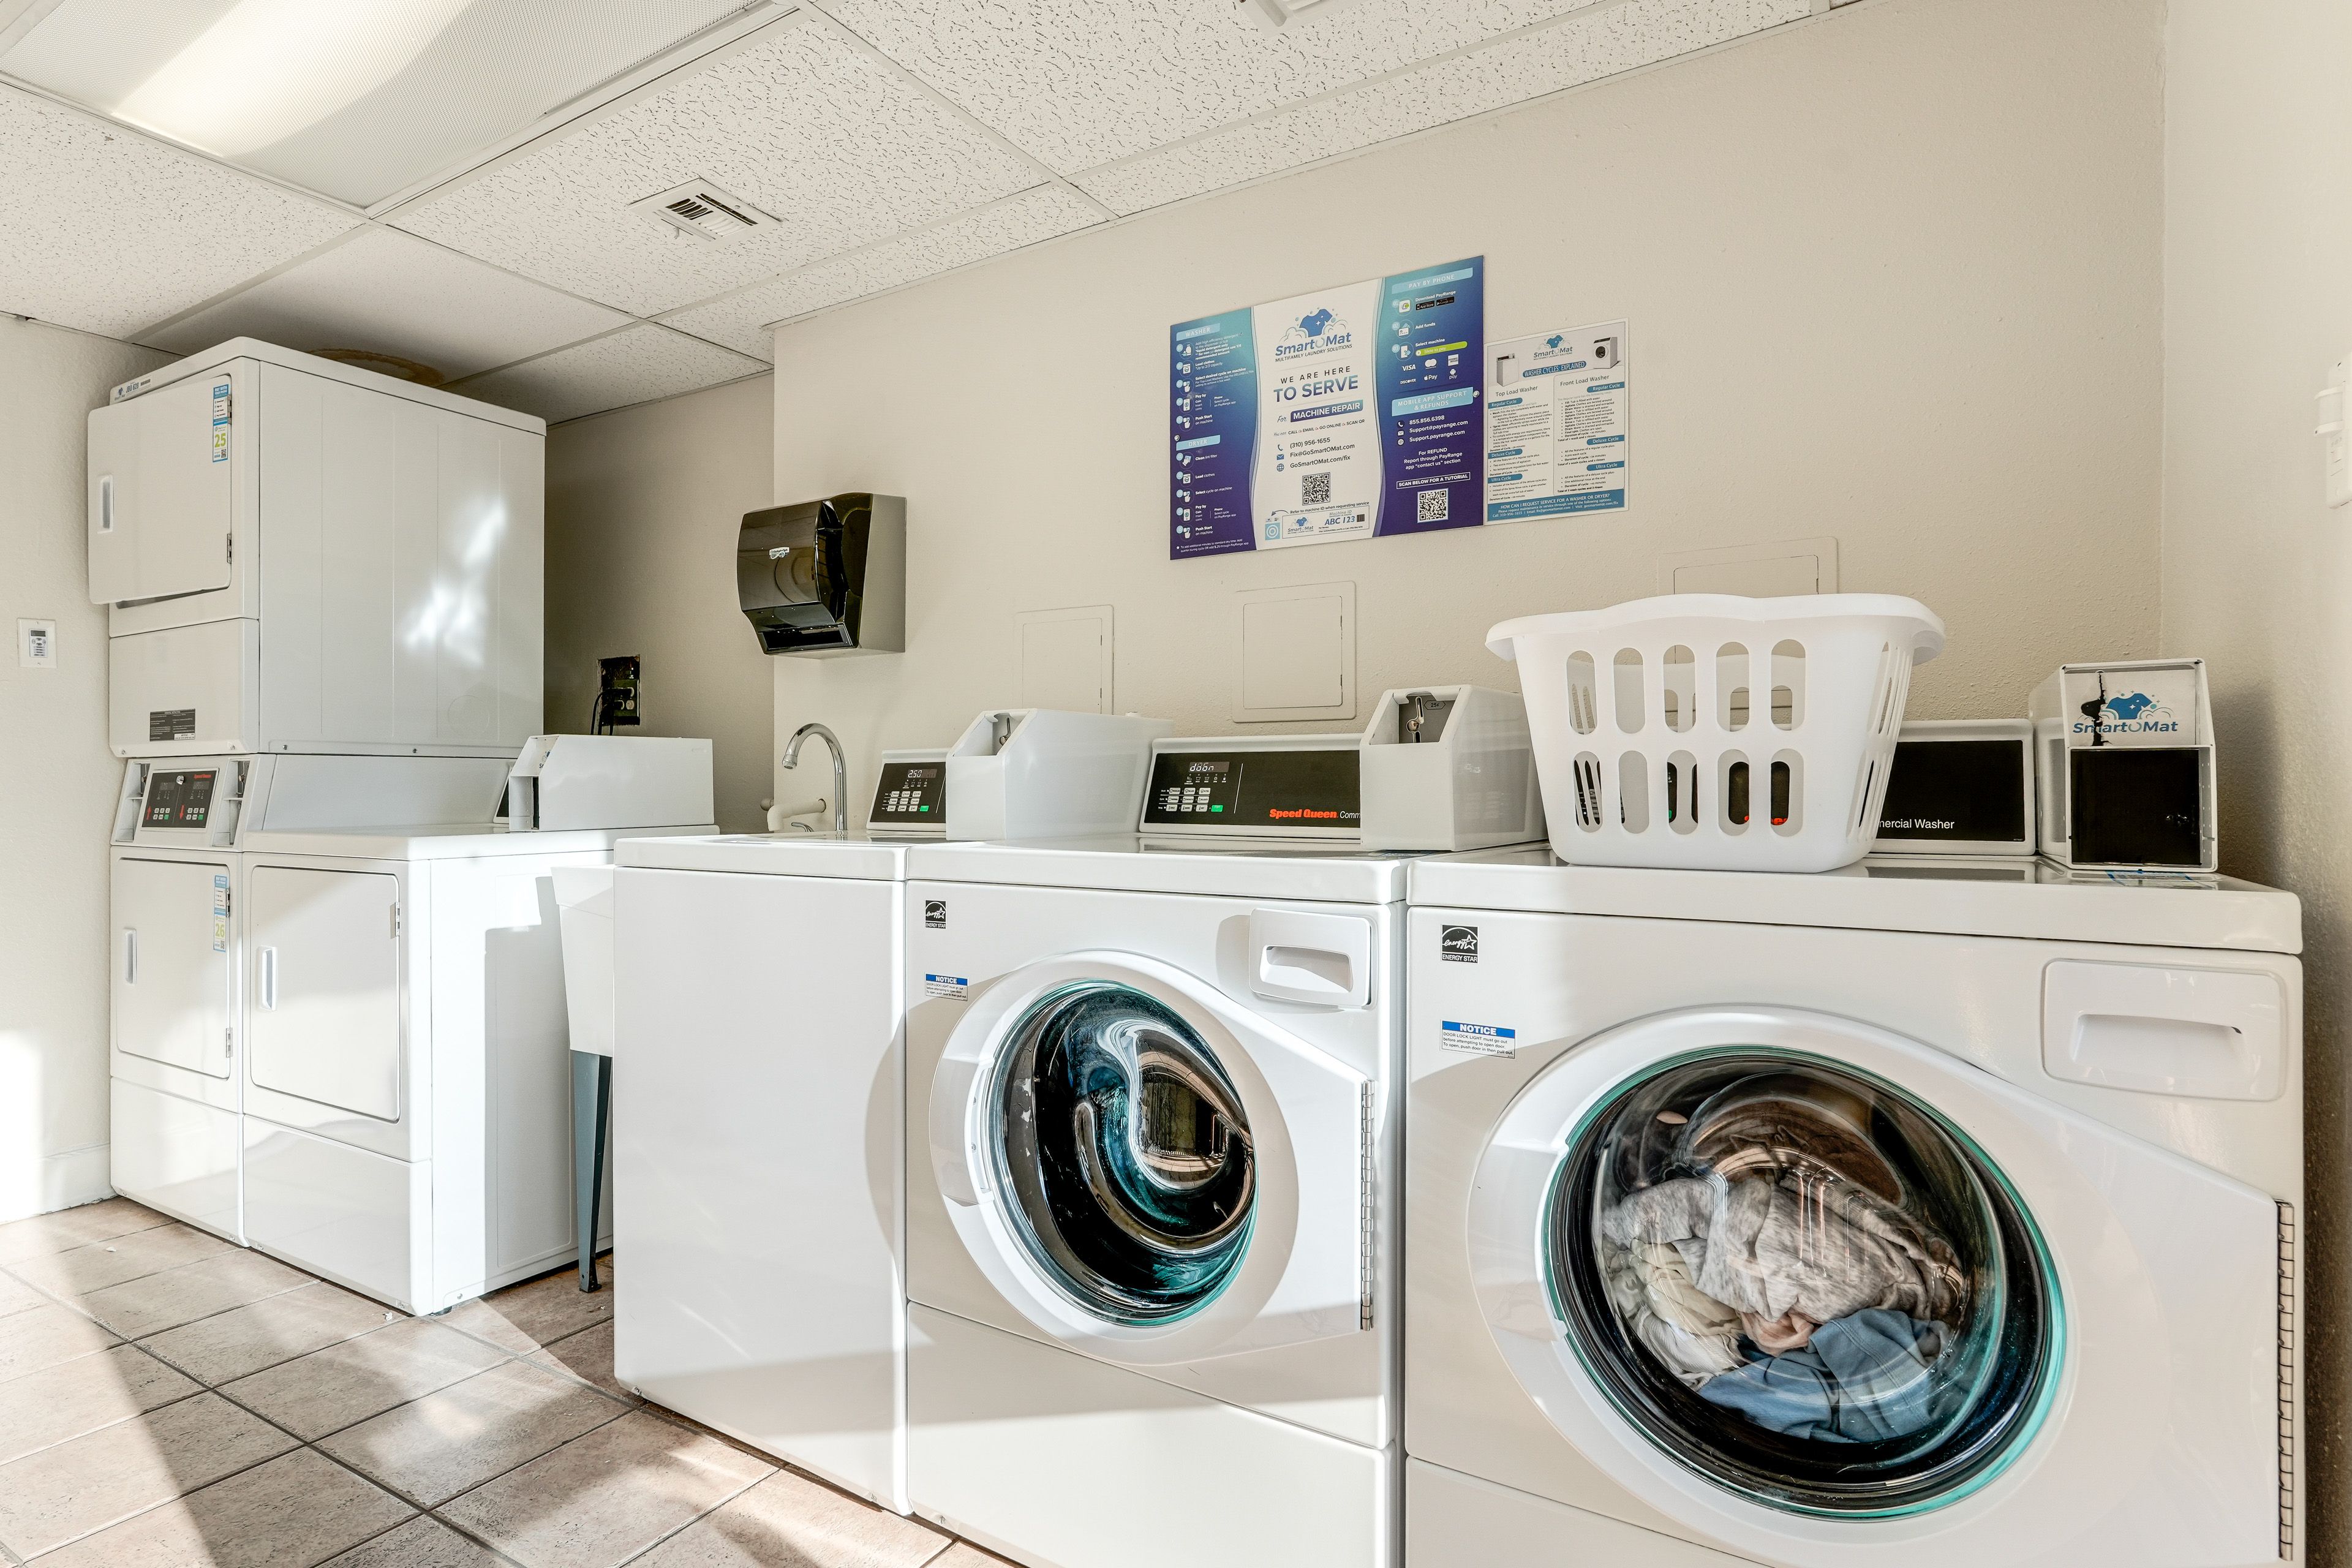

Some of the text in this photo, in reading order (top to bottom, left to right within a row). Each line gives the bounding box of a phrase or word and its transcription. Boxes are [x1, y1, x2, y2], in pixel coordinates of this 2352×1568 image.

[1185, 327, 1211, 337] WASHER
[1275, 353, 1303, 362] MULTIFAMILY
[1327, 344, 1352, 353] SOLUTIONS
[1300, 372, 1318, 381] ARE
[1325, 366, 1351, 376] HERE
[1524, 361, 1585, 377] WASHER CYCLES: EXPLAINED
[1273, 375, 1359, 402] TO SERVE
[1398, 398, 1422, 407] MOBILE
[1437, 391, 1468, 399] SUPPORT
[1421, 401, 1449, 409] REFUNDS
[1294, 408, 1330, 419] MACHINE
[1332, 402, 1360, 413] REPAIR
[1409, 415, 1444, 424] 855.856.6398
[1409, 420, 1468, 433] Support@payrange.com
[214, 432, 226, 448] 25
[1305, 437, 1330, 446] 956-1655
[1409, 430, 1465, 442] Support.payrange.com
[1290, 444, 1355, 458] Fix@GoSmartOMat.com
[1290, 455, 1351, 468] GoSmartOMat.com/fix
[1269, 809, 1302, 819] Speed
[1303, 809, 1338, 818] Queen
[1915, 820, 1955, 829] Washer
[216, 923, 225, 938] 26
[1460, 1023, 1497, 1035] NOTICE
